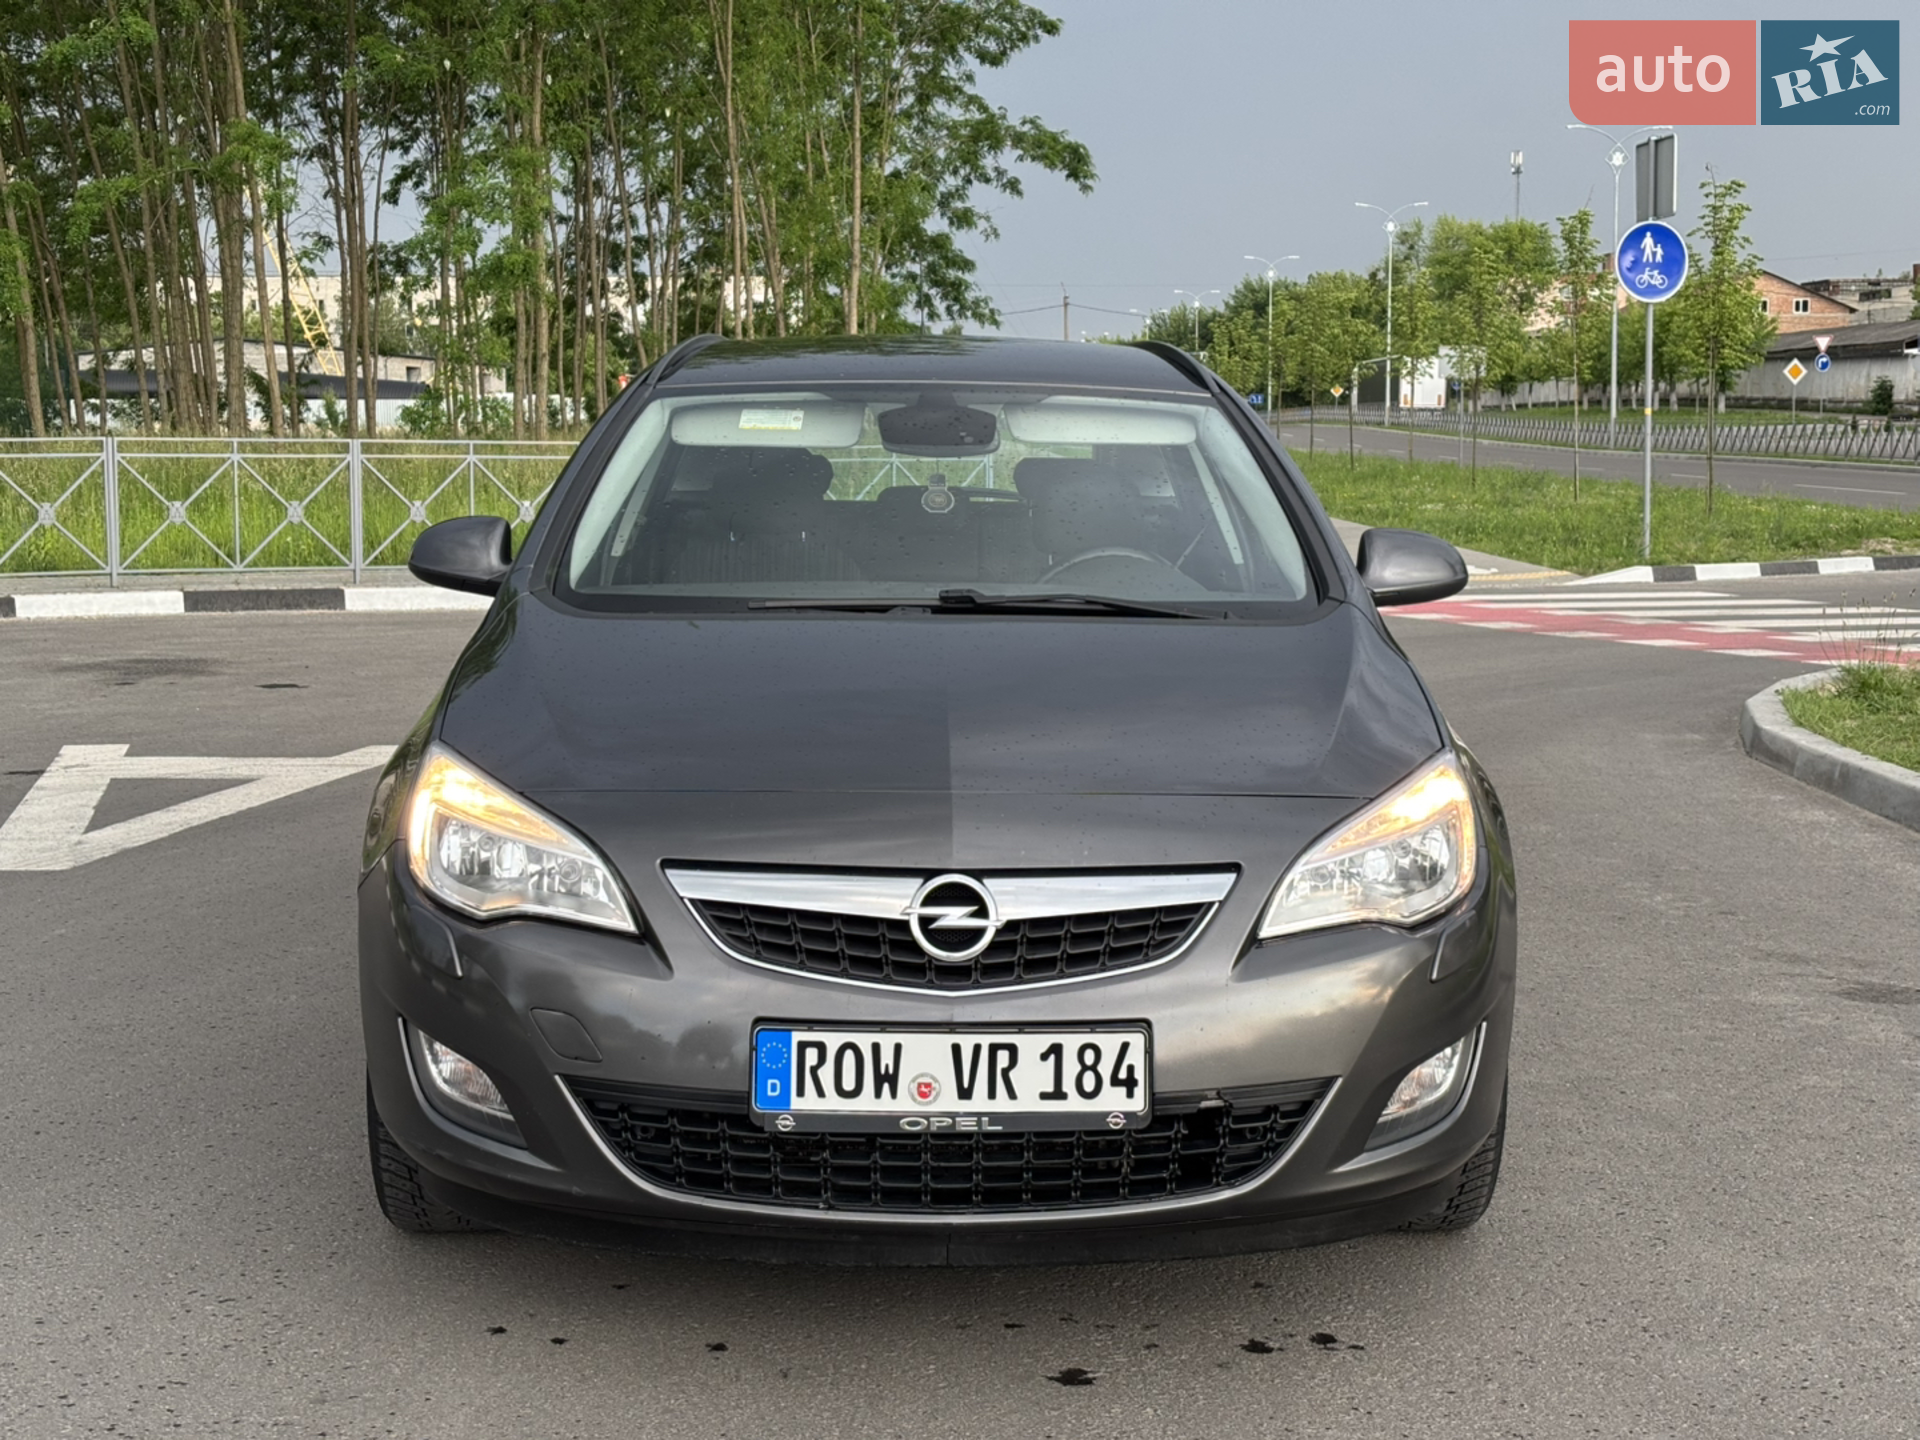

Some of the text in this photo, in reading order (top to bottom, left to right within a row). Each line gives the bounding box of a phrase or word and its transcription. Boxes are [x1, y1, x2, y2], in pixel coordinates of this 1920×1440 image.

[796, 1040, 903, 1099] ROW
[951, 1042, 1019, 1100] VR
[1039, 1041, 1139, 1100] 184
[767, 1079, 780, 1096] D
[899, 1116, 1003, 1131] OPEL
